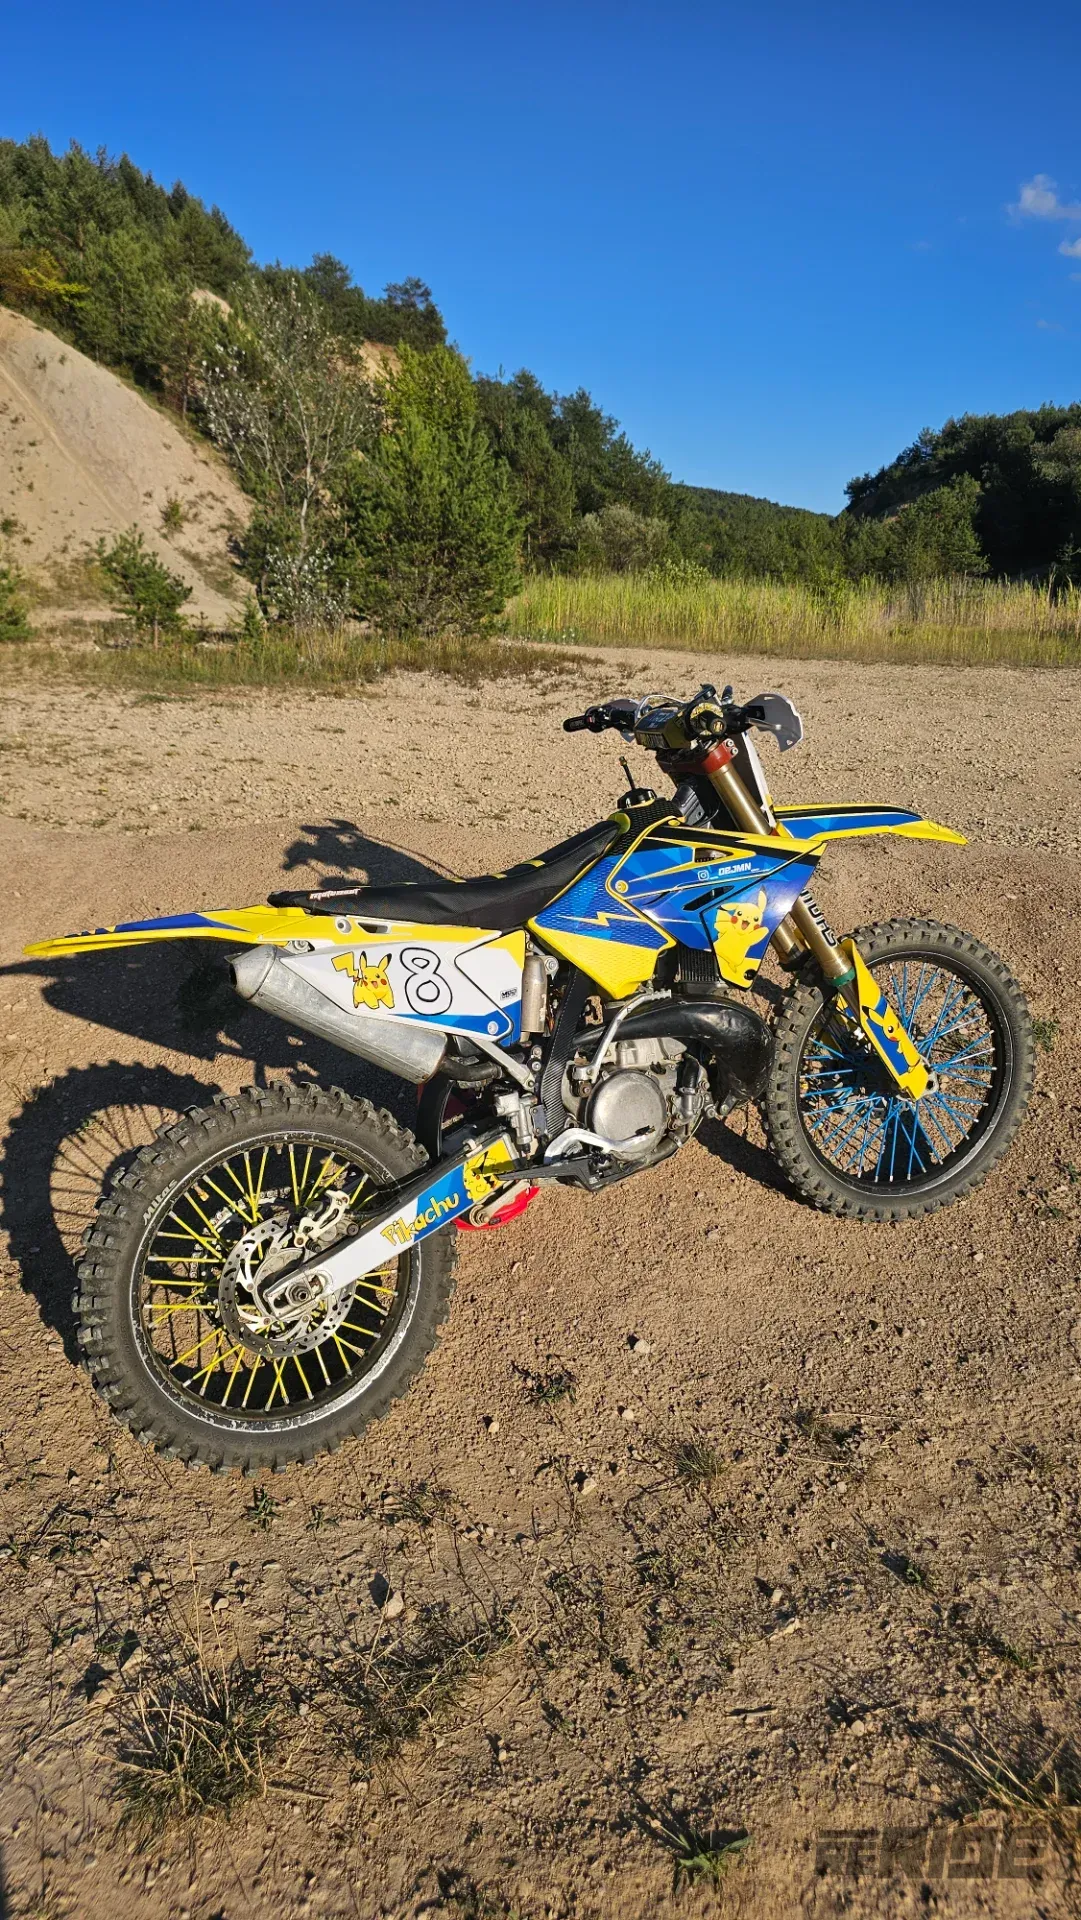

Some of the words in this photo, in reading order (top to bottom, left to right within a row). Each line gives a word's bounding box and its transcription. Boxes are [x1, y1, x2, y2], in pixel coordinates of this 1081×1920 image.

[399, 947, 453, 1016] 8
[142, 1179, 178, 1226] Mitas
[380, 1192, 460, 1246] Pikachu
